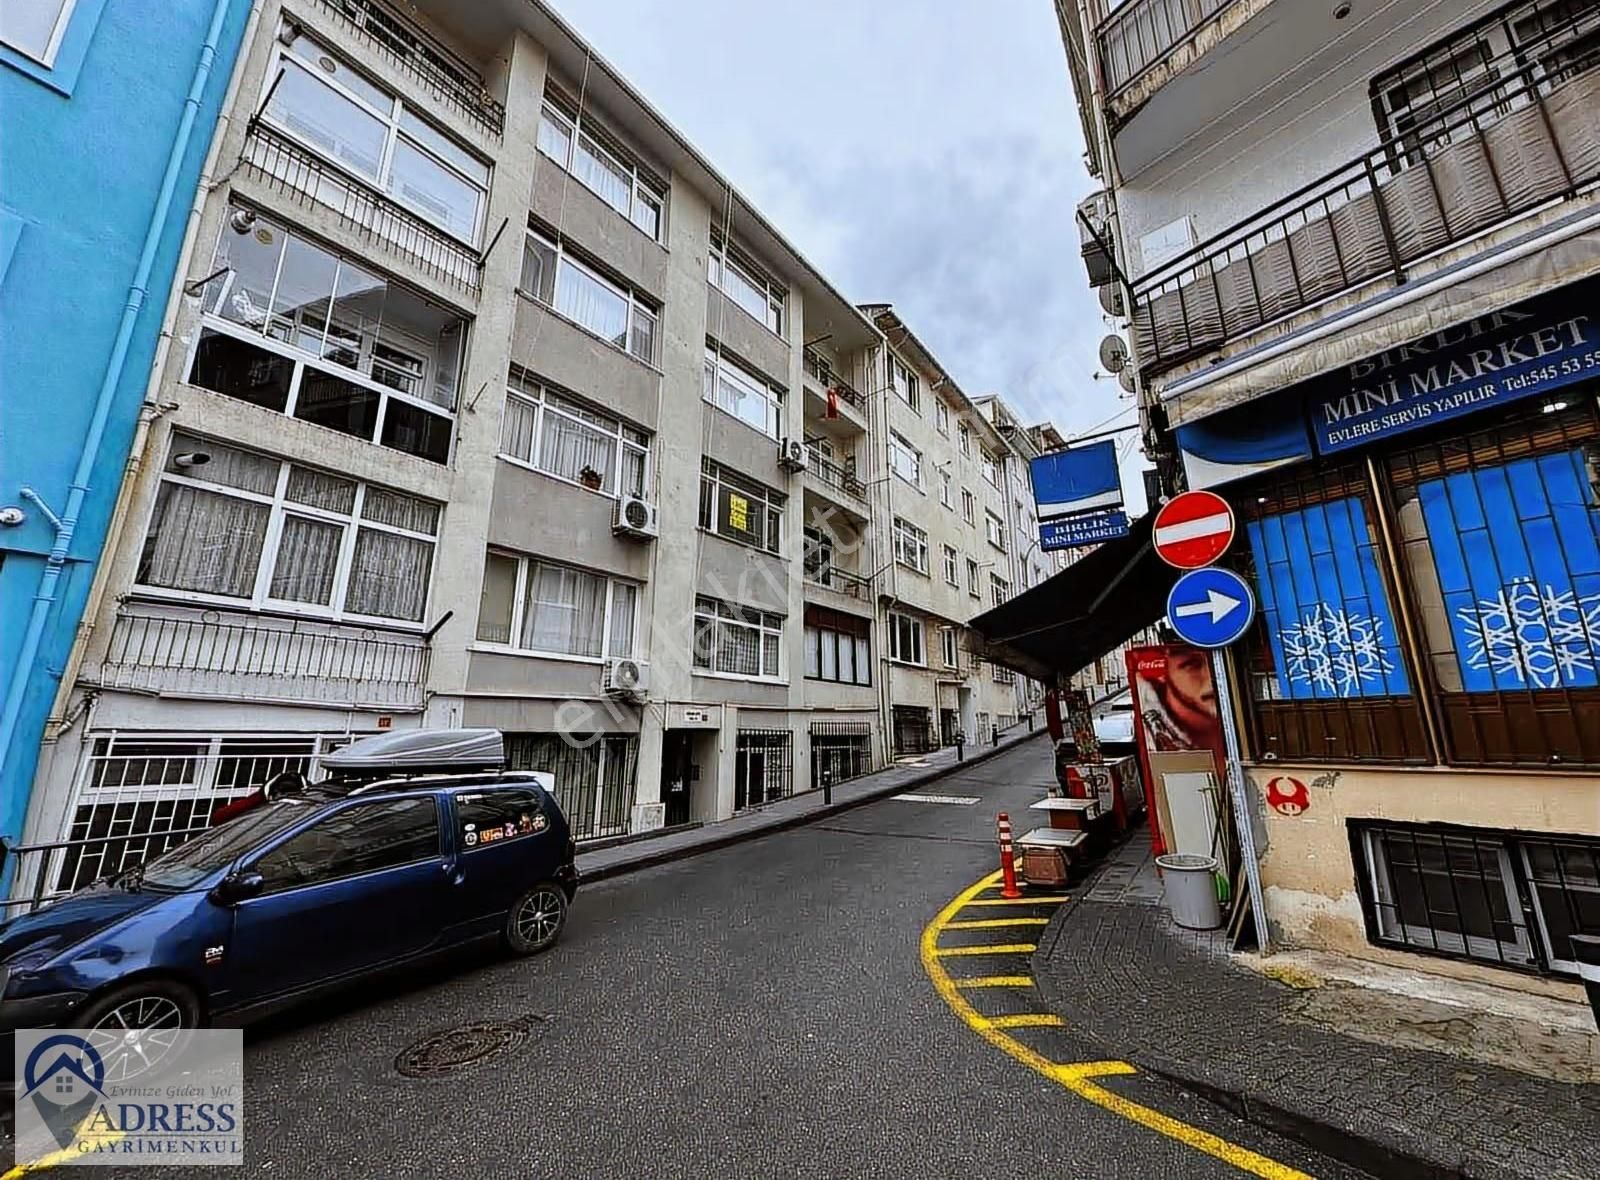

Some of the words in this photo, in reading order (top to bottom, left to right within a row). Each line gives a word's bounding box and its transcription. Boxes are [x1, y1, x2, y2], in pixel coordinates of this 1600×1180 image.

[1321, 373, 1404, 426] MİNİ
[1410, 315, 1589, 397] MARKET
[1327, 420, 1381, 446] EVLERE
[1380, 402, 1431, 430] SERVİS
[1433, 383, 1498, 414] YAPILIR
[1562, 358, 1581, 375] 53
[1073, 526, 1125, 541] MARKET
